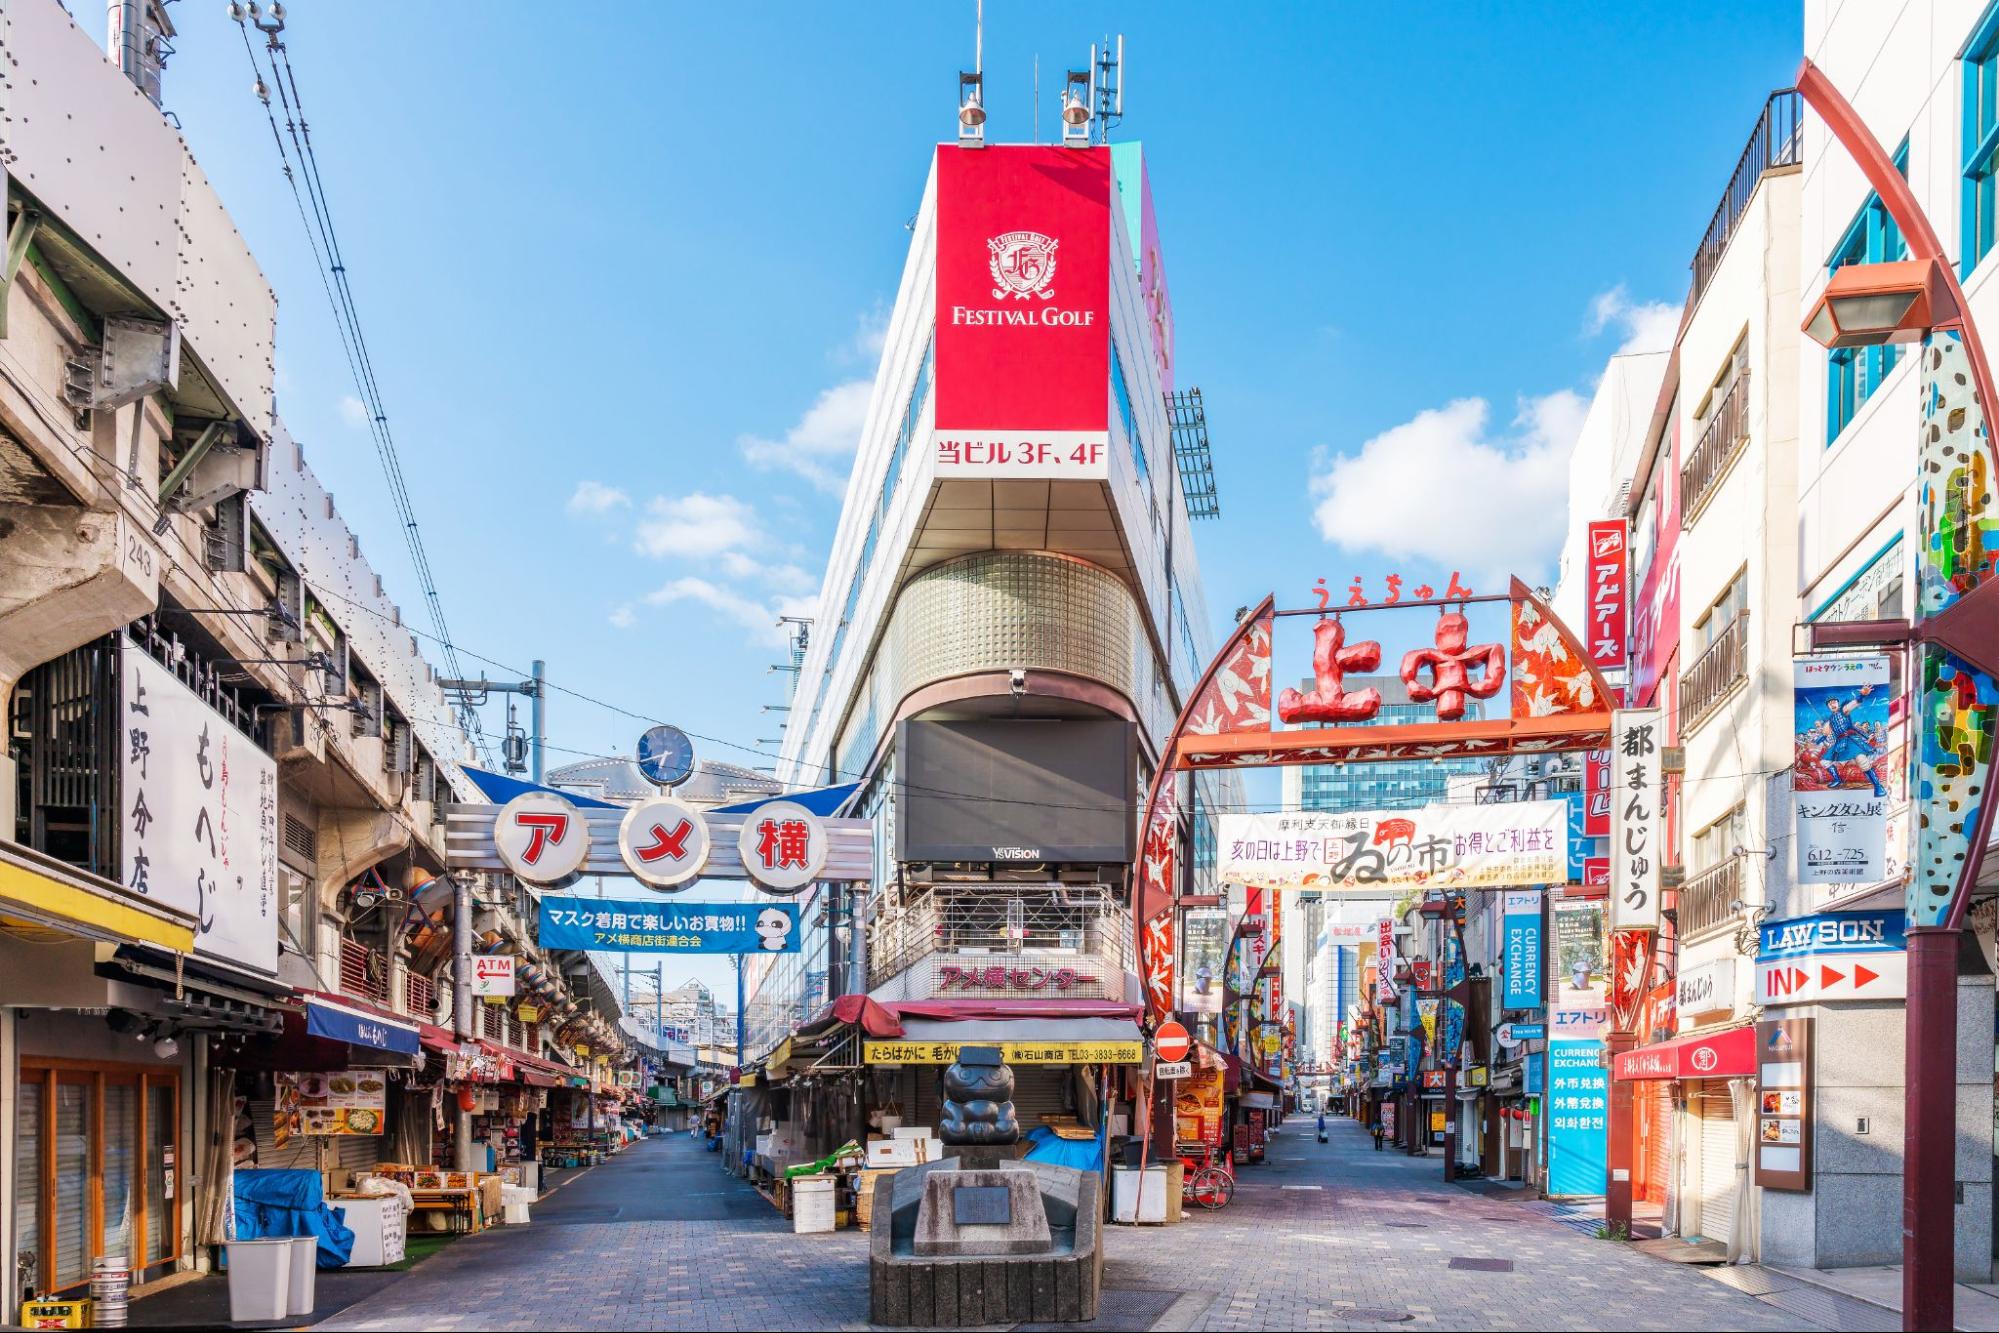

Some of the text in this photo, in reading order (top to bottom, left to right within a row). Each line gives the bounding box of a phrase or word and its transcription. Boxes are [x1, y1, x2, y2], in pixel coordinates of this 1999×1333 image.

[952, 306, 1094, 326] FESTIVAL GOLF
[129, 534, 151, 577] 243
[1594, 563, 1620, 659] アドアーズ
[130, 667, 153, 895] 上野分店
[1620, 724, 1655, 911] 都まんじゅう
[1797, 802, 1883, 819] キングダム展
[194, 720, 217, 934] もへじ
[515, 812, 810, 870] アメ横
[1231, 839, 1322, 862] 亥の日は上野で
[1455, 827, 1554, 856] お得とご利益を
[1807, 849, 1832, 861] 6.12
[1508, 896, 1540, 906] エアトリ
[548, 909, 746, 932] マスク着用で楽しいお買物!!
[593, 932, 702, 948] アメ横商店街連合会
[1767, 919, 1885, 950] LAWSON
[476, 959, 511, 970] ATM
[1510, 928, 1522, 995] EXCHANGE
[1524, 928, 1537, 995] CURRENCY
[940, 966, 1097, 991] アメ横センター
[1767, 966, 1792, 998] IN
[1555, 1011, 1607, 1025] エアトリ
[871, 1046, 925, 1061] たらばがに
[1012, 1049, 1064, 1061] (株)石山商店
[1554, 1048, 1600, 1057] CURRENC
[1554, 1077, 1605, 1090] 外币兑换
[1554, 1117, 1604, 1129] 외화환전
